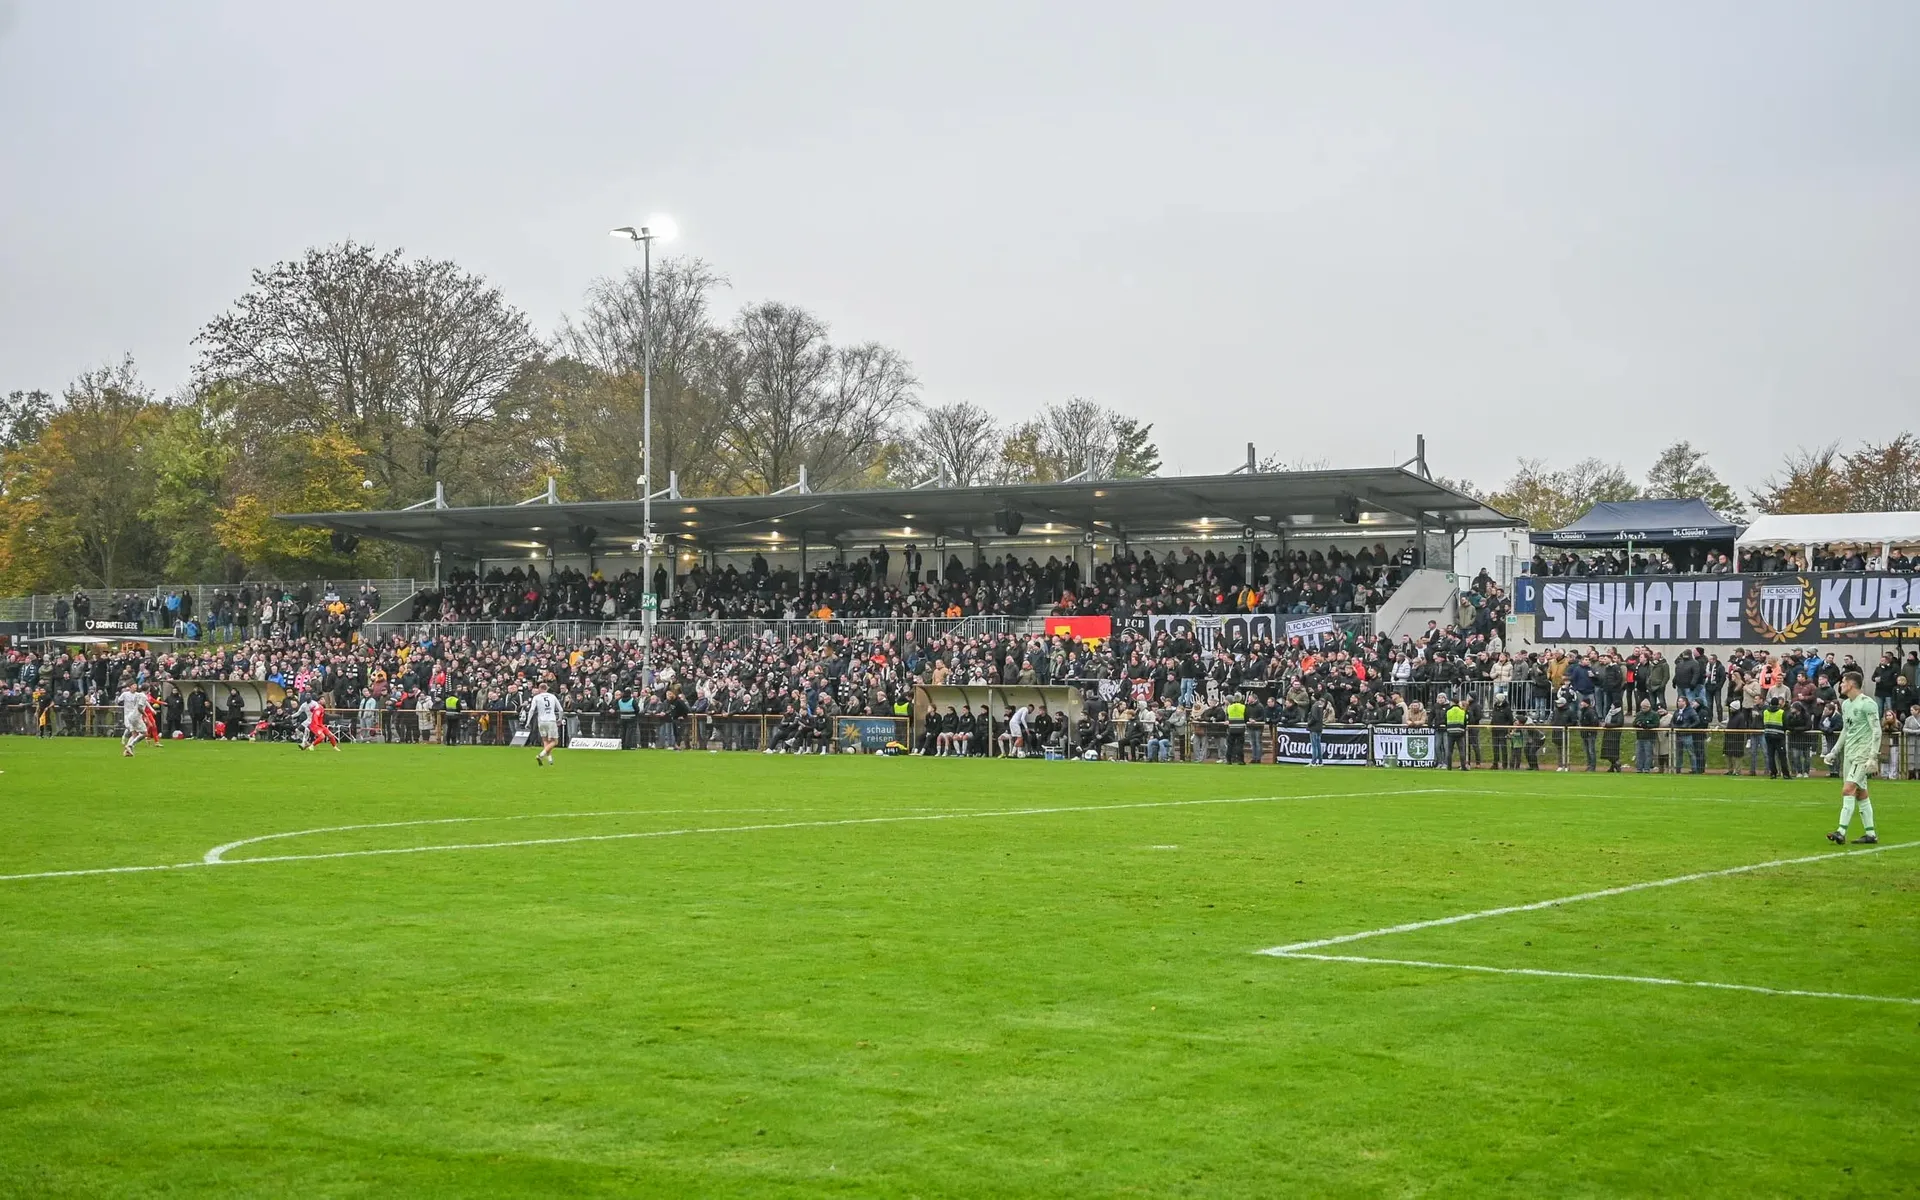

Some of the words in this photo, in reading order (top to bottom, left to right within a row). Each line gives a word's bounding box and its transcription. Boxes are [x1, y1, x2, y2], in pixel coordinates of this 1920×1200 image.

[1525, 585, 1535, 602] D
[1542, 580, 1744, 639] SCHWATTE
[1125, 618, 1145, 628] FCB
[1302, 618, 1330, 629] BOCHOLT
[543, 696, 551, 708] 5
